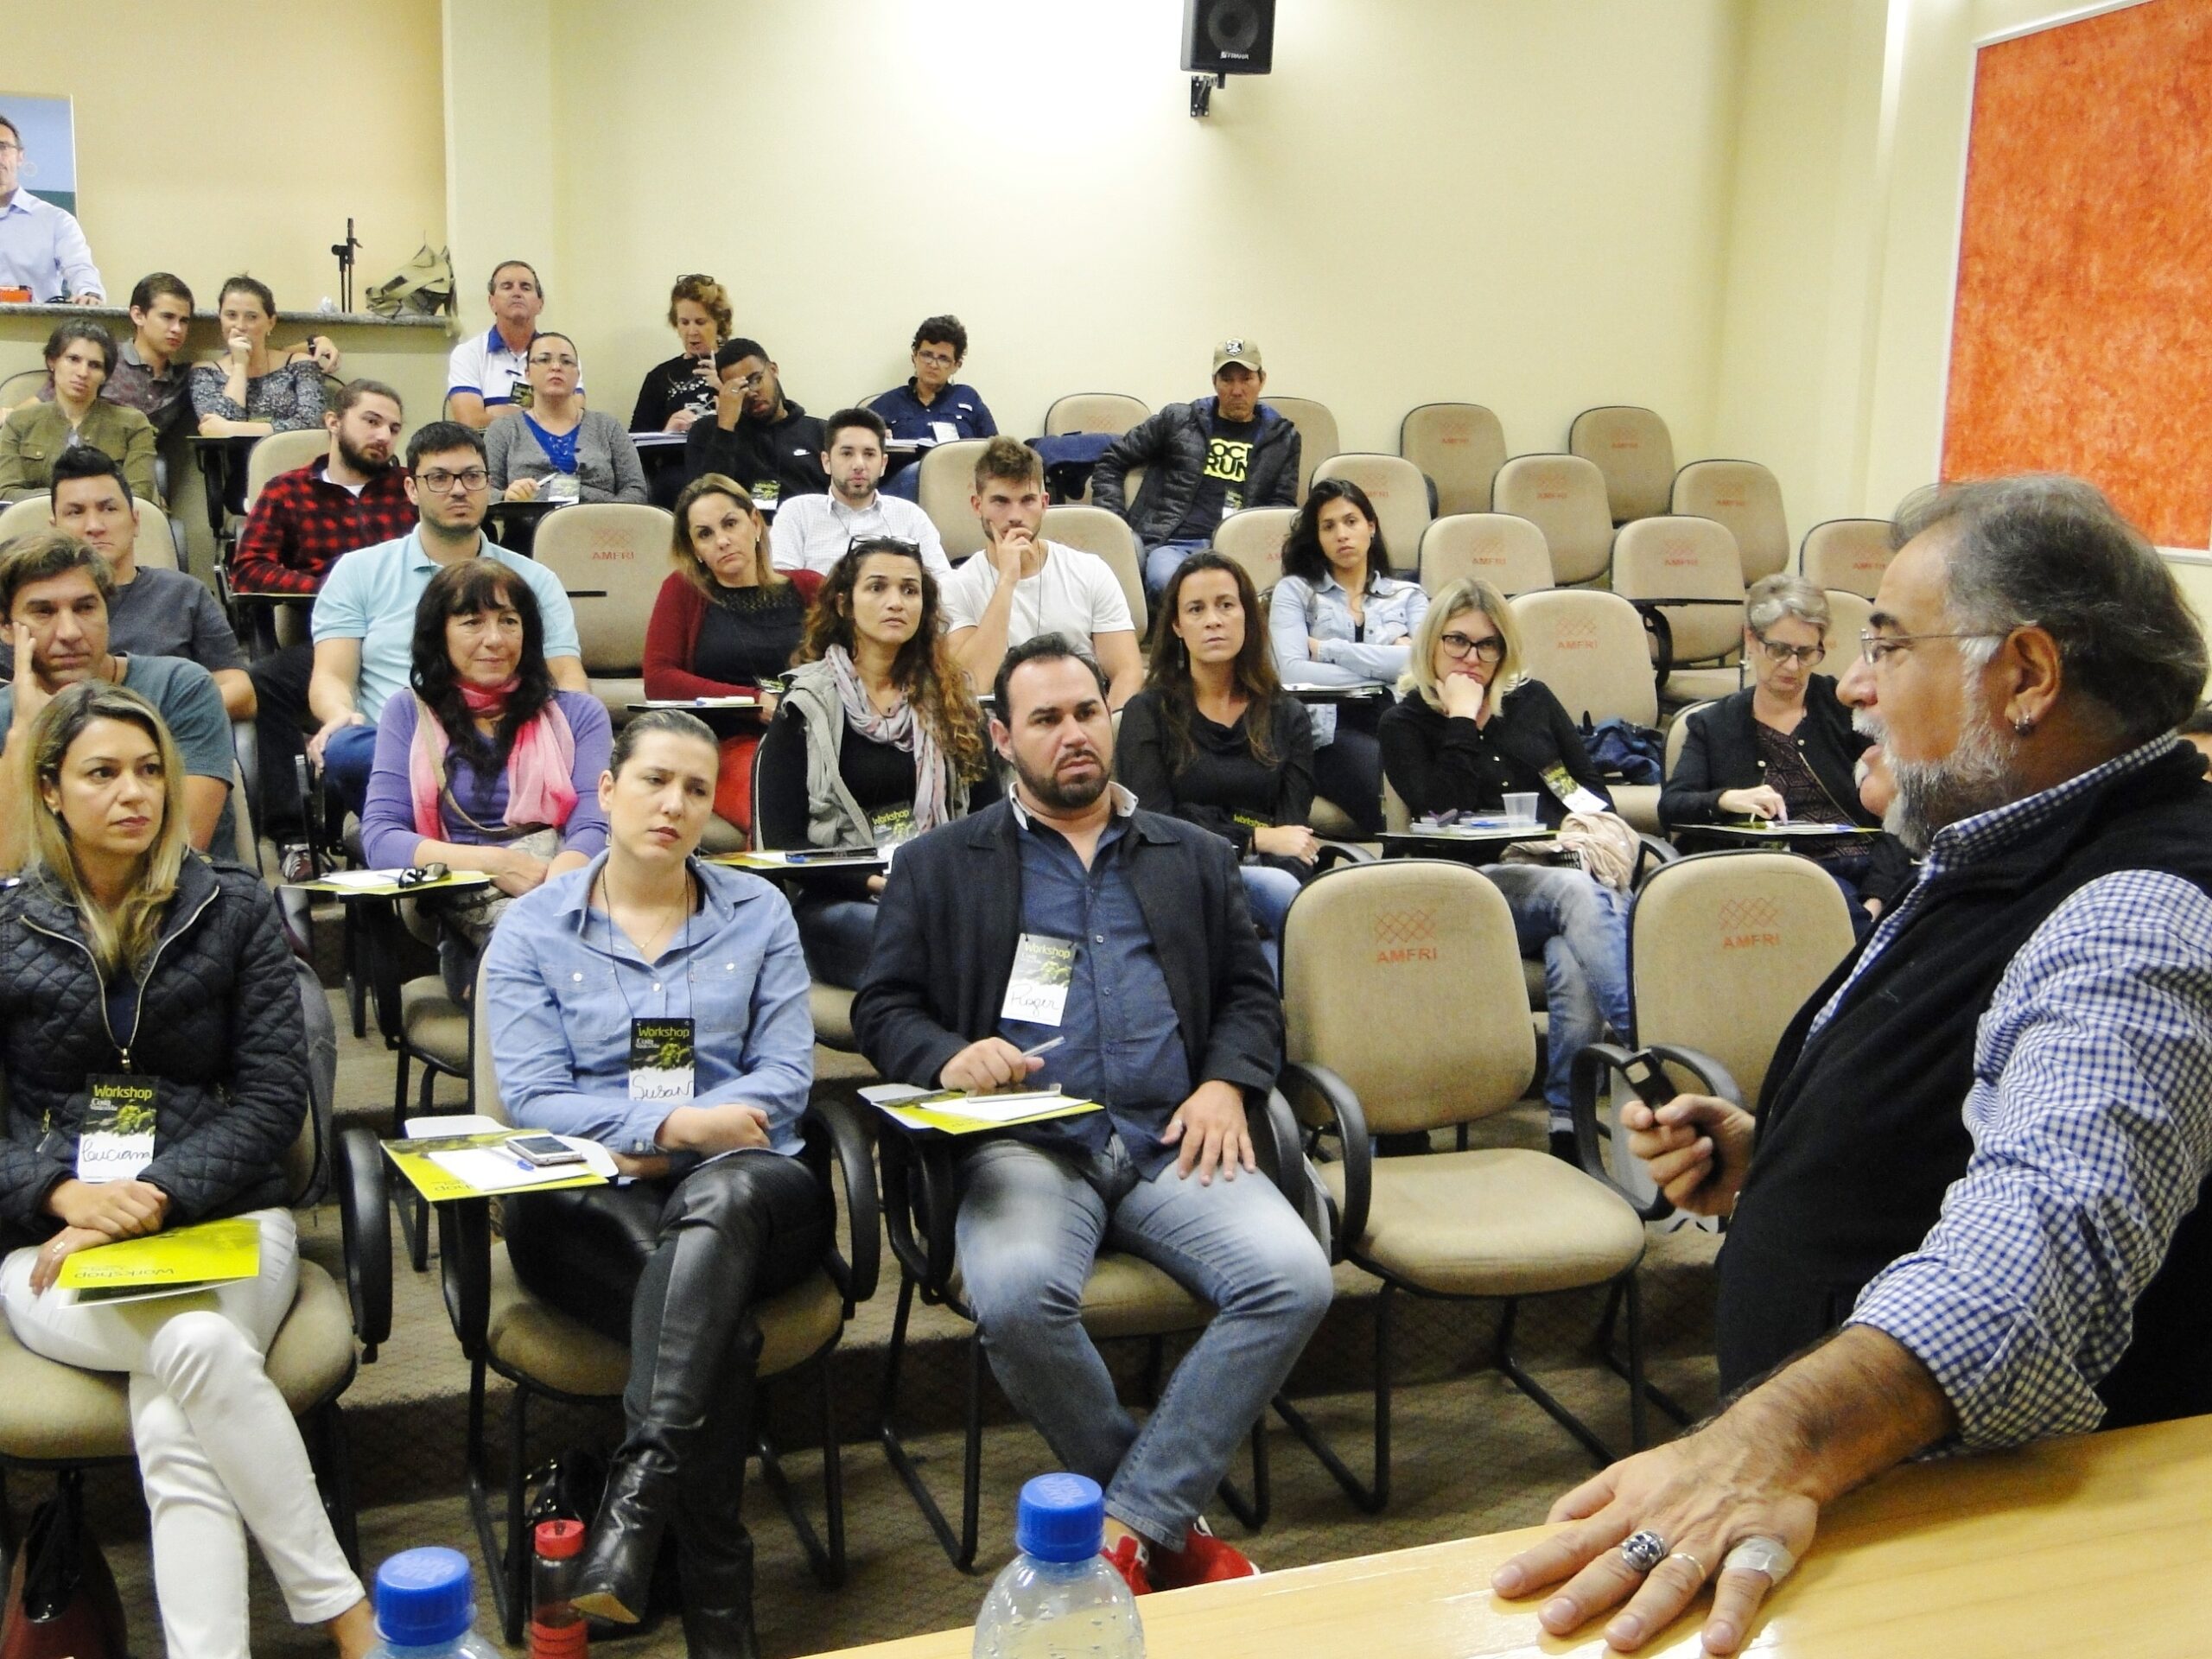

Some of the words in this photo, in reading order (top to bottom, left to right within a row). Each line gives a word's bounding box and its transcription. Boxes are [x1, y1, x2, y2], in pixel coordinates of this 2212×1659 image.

[1211, 442, 1250, 460] OC
[592, 550, 635, 561] AMFRI
[1557, 639, 1599, 650] AMFRI
[1722, 932, 1780, 950] AMFRI
[1025, 942, 1071, 960] Workshop
[1376, 947, 1439, 963] AMFRI
[639, 1026, 690, 1039] Workshop
[93, 1084, 153, 1101] Workshop
[74, 1268, 175, 1279] Workshop
